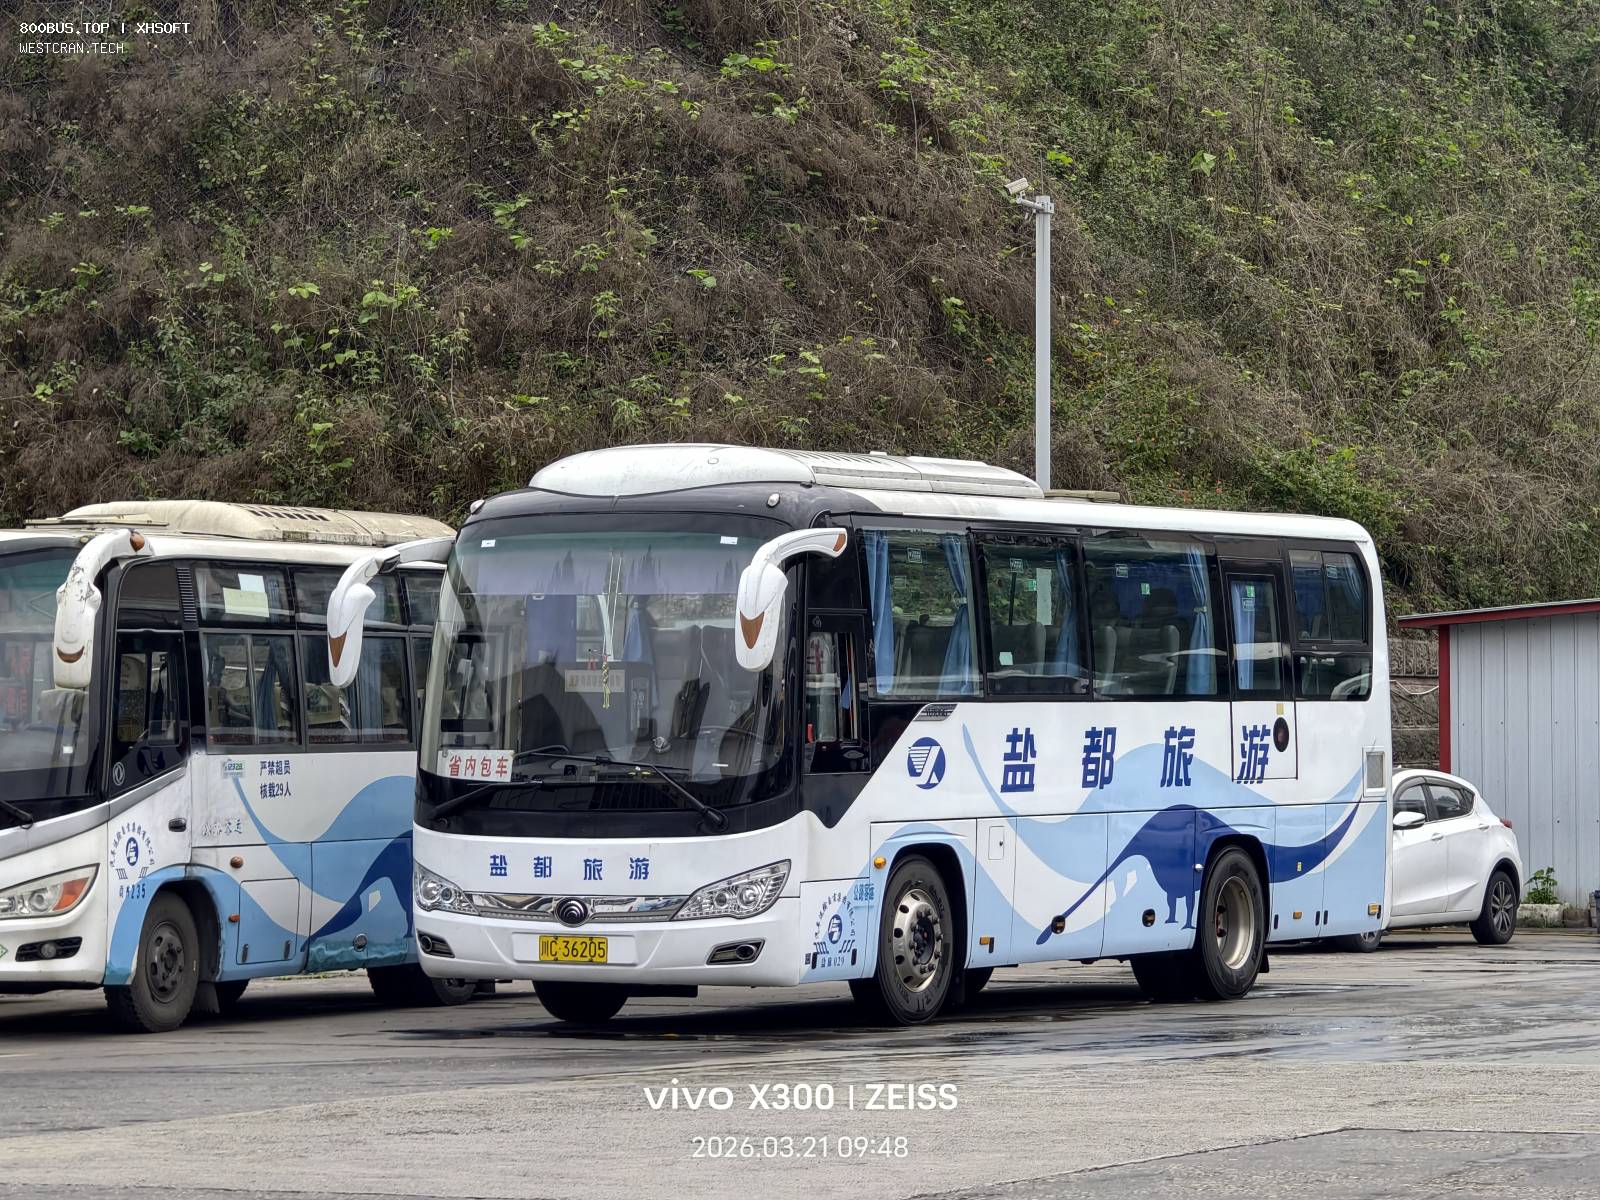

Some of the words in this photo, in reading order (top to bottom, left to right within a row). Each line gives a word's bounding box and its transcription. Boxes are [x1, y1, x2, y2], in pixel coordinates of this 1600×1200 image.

[260, 760, 291, 776] 严禁超员
[448, 754, 509, 777] 省内包车
[1000, 724, 1271, 793] 盐都旅游
[260, 781, 292, 799] 核载29人
[489, 854, 650, 881] 盐都旅游
